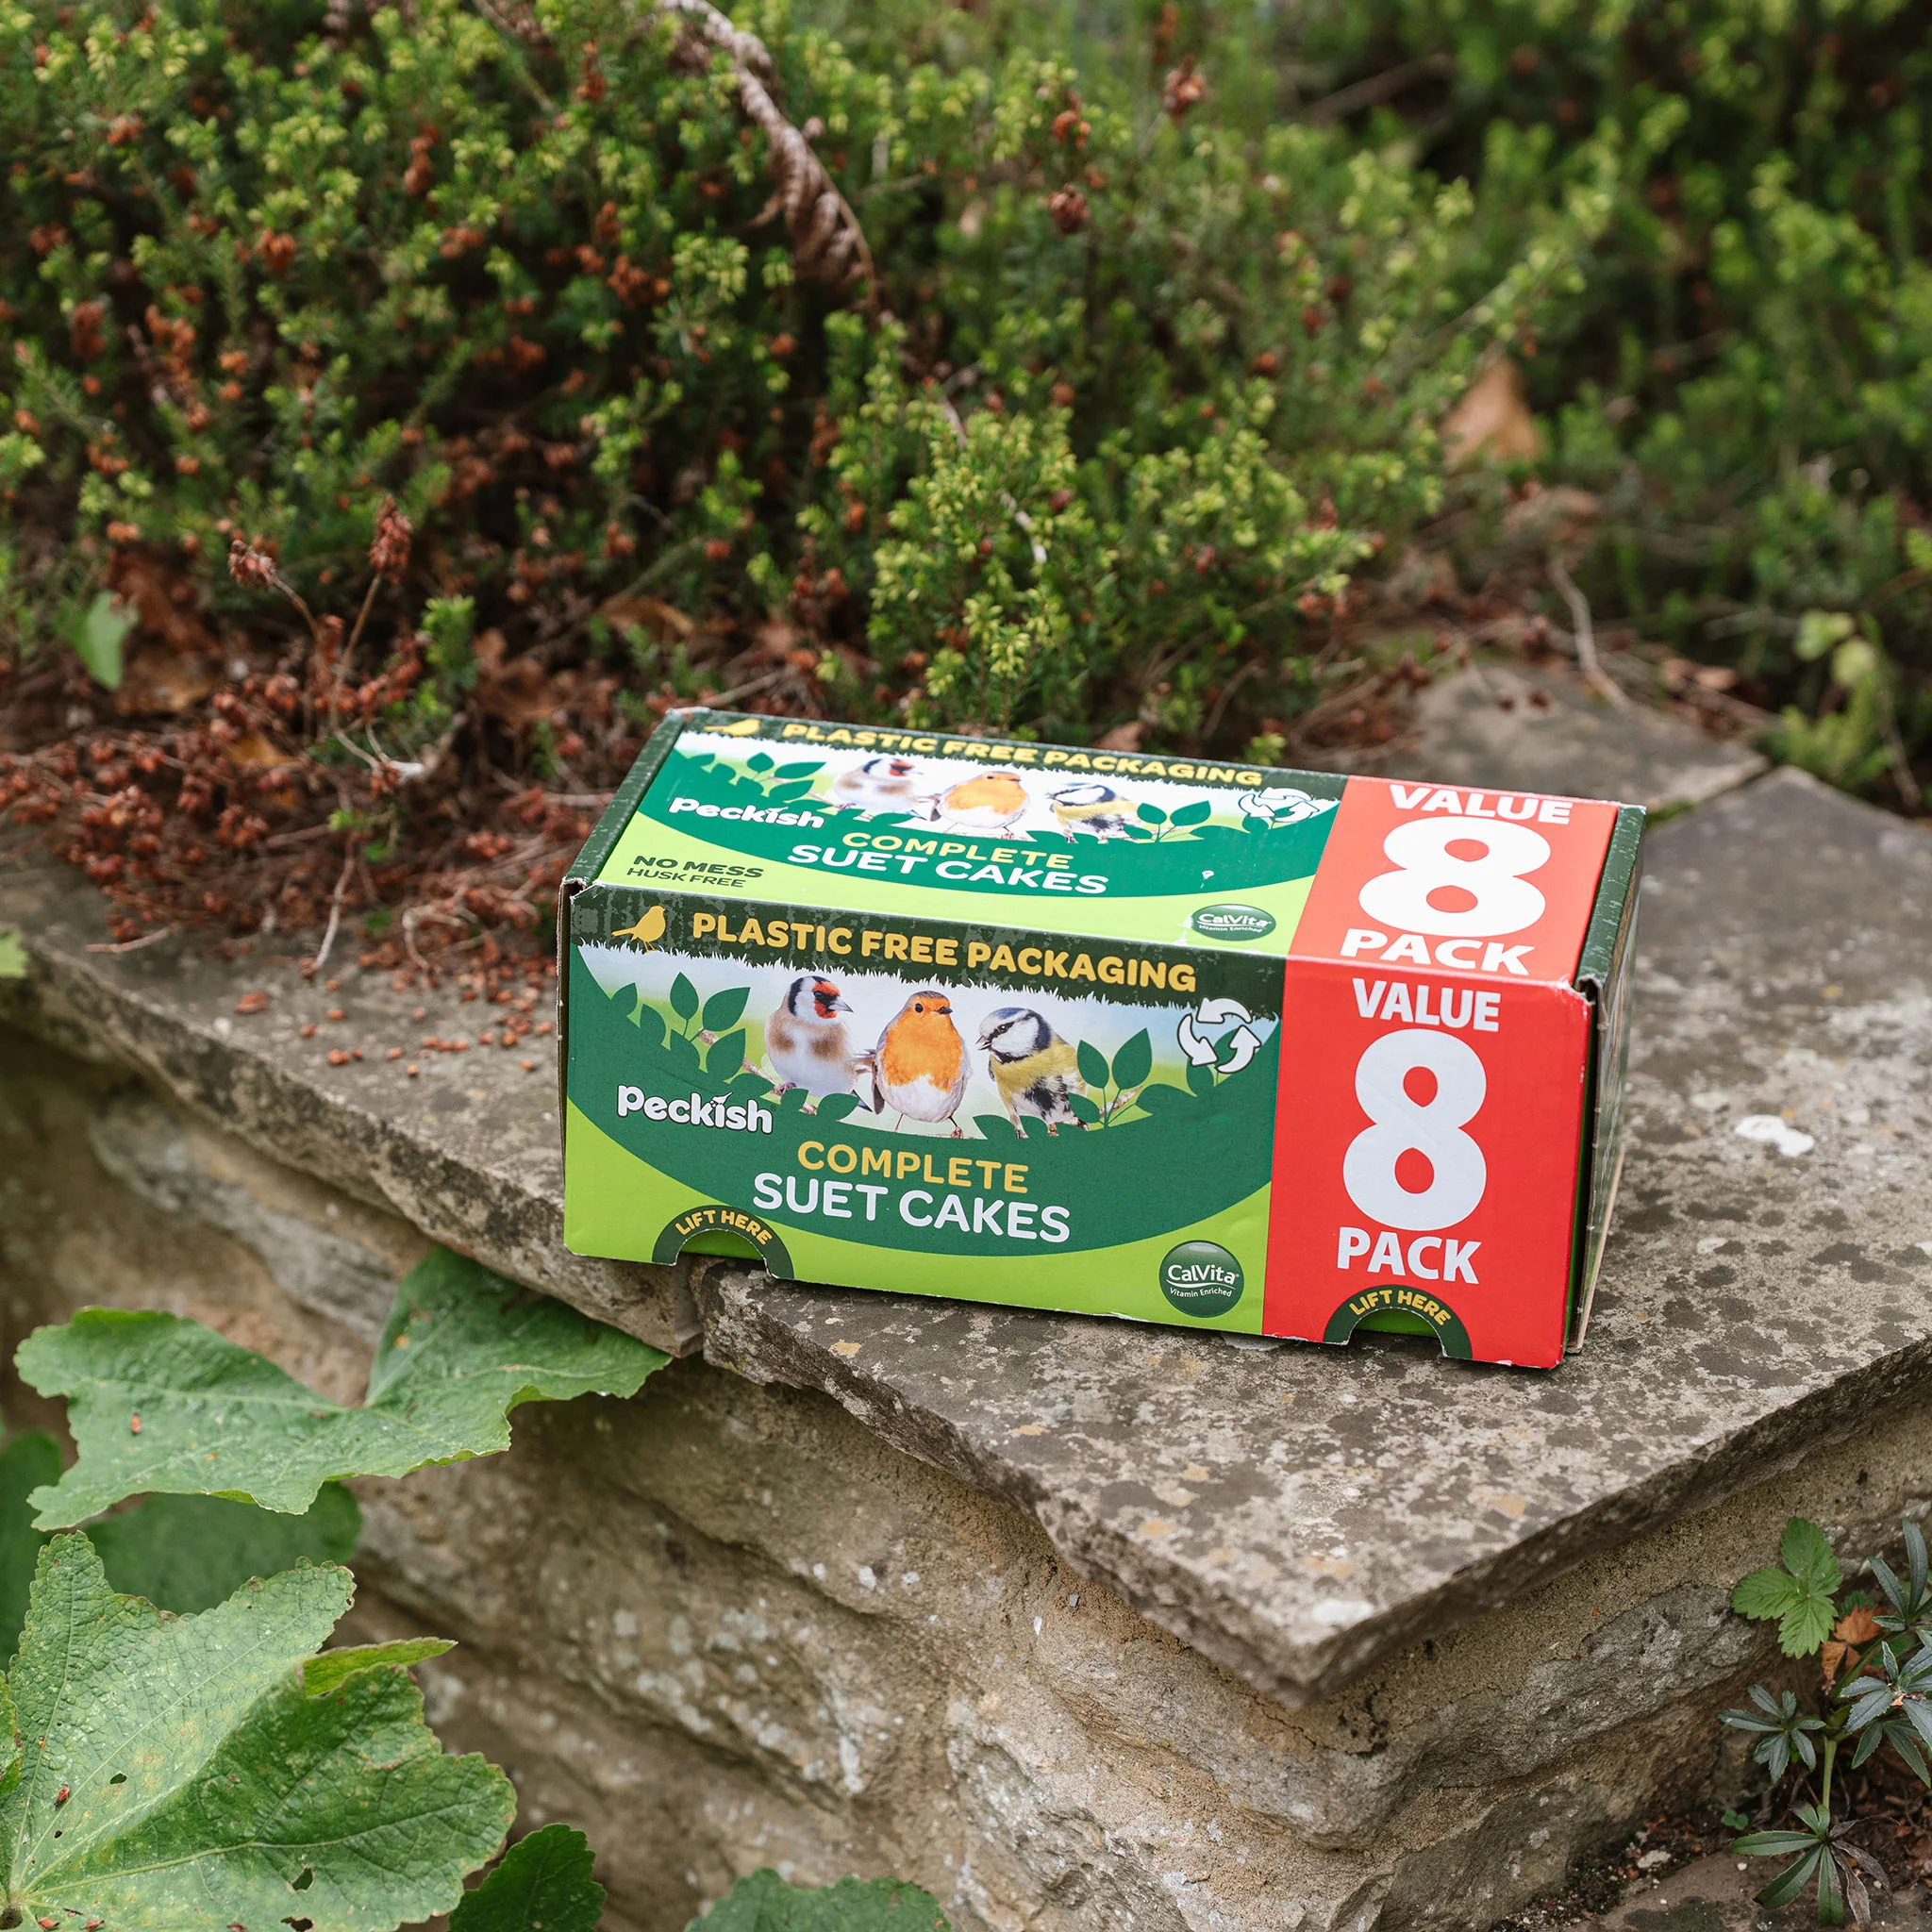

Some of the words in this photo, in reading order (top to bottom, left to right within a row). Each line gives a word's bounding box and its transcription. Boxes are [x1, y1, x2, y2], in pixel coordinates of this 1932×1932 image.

[782, 723, 937, 754] PLASTIC
[941, 740, 1037, 763] FREE
[1043, 748, 1263, 786] PACKAGING
[668, 796, 825, 829] Peckish
[1389, 784, 1574, 824] VALUE
[632, 855, 678, 870] NO
[683, 860, 764, 878] MESS
[787, 845, 928, 874] SUET
[935, 859, 1109, 894] CAKES
[841, 831, 1074, 870] COMPLETE
[626, 867, 688, 881] HUSK
[690, 874, 747, 888] FREE
[1358, 816, 1551, 937] 8
[1198, 913, 1269, 927] CalVita
[692, 911, 853, 953] PLASTIC
[860, 930, 958, 966] FREE
[967, 941, 1197, 992] PACKAGING
[1340, 928, 1535, 975] PACK
[1352, 977, 1502, 1032] VALUE
[617, 1084, 774, 1134] Peckish
[1342, 1028, 1487, 1231] 8
[797, 1141, 1028, 1193] COMPLETE
[675, 1209, 716, 1236] LIFT
[720, 1209, 772, 1245] HERE
[753, 1173, 889, 1222] SUET
[898, 1189, 1071, 1243] CAKES
[1168, 1264, 1236, 1284] CalVita
[1337, 1226, 1482, 1285] PACK
[1169, 1287, 1198, 1297] Vitamin
[1200, 1288, 1232, 1297] Enriched
[1349, 1290, 1392, 1316] LIFT
[1397, 1290, 1451, 1326] HERE
